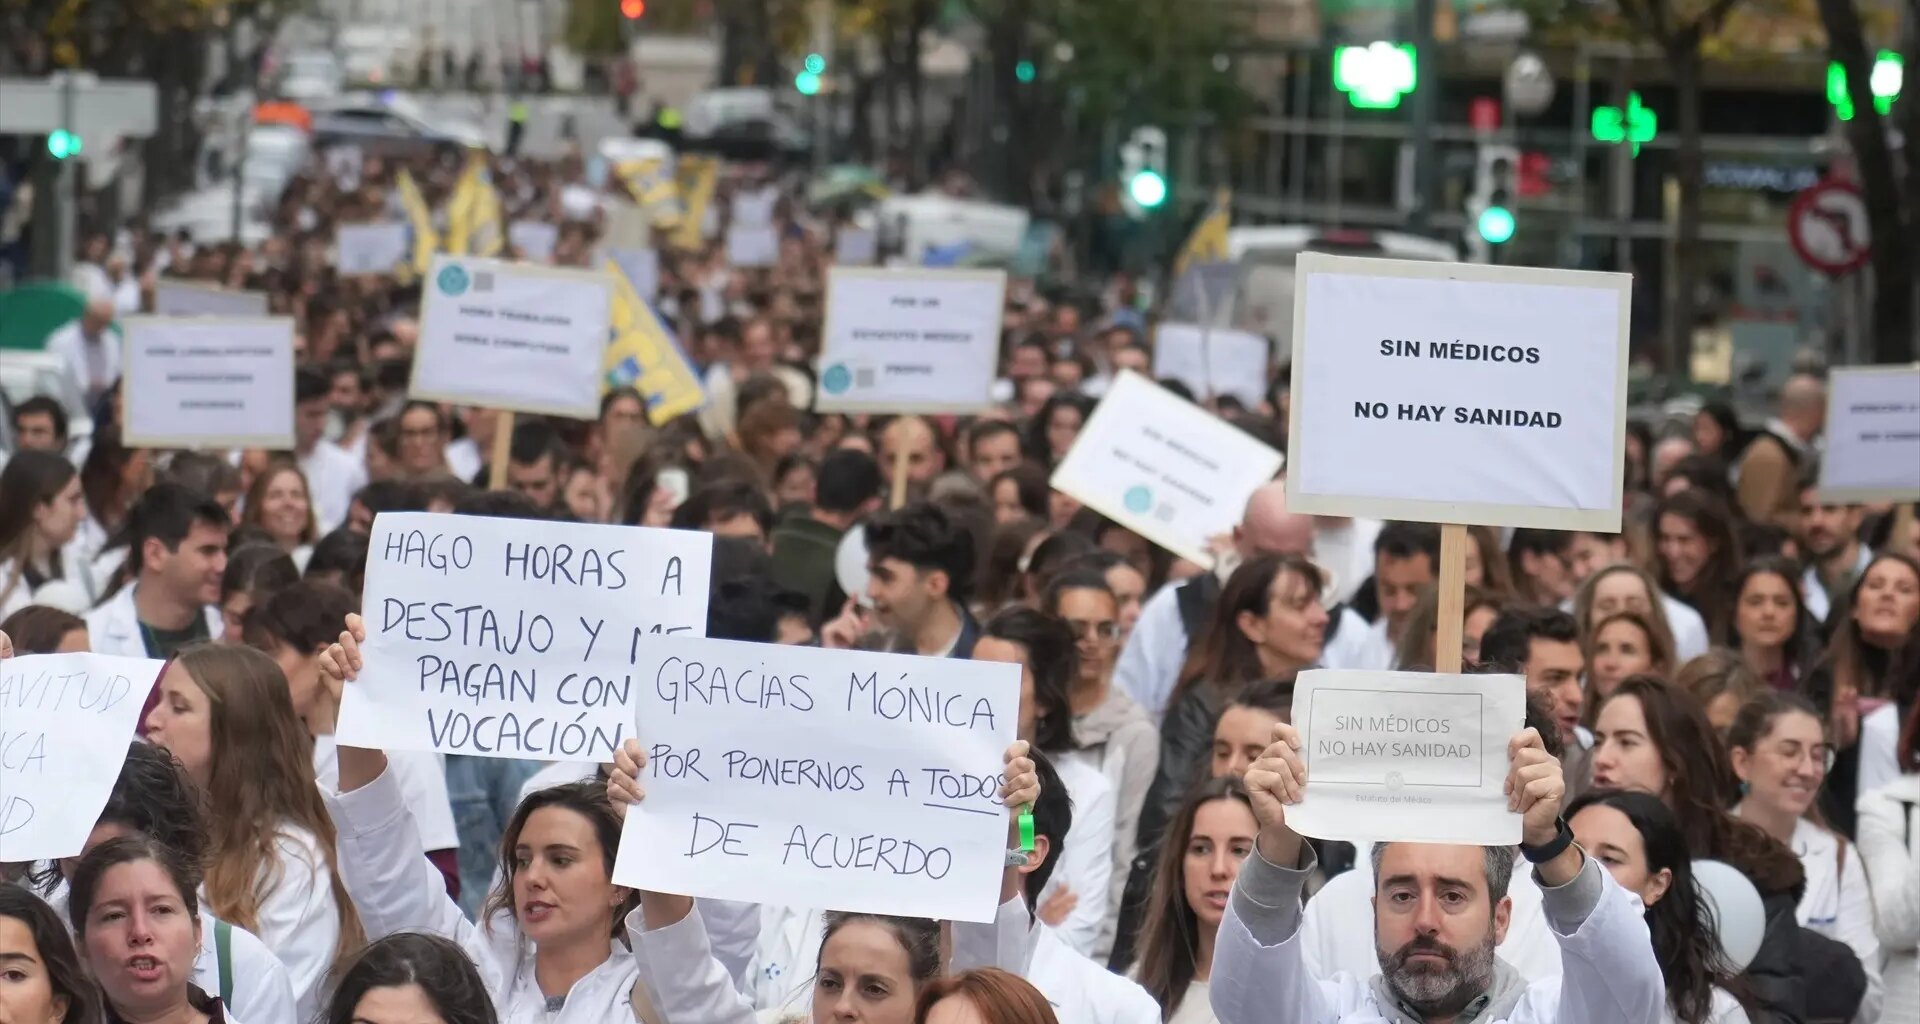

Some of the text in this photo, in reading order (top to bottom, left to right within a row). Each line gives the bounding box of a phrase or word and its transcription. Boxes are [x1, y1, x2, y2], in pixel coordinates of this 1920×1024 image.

[1380, 339, 1540, 364] SIN MÉDICOS
[1354, 401, 1562, 428] NO HAY SANIDAD
[385, 530, 682, 596] HAGO HORAS A
[382, 598, 554, 655] DESTAJO
[580, 616, 605, 662] Y
[417, 655, 631, 708] PAGAN CON
[848, 672, 995, 731] MÓNICA
[427, 711, 623, 756] VOCACIÓN
[1335, 714, 1450, 733] SIN MÉDICOS
[650, 744, 709, 782] POR
[722, 750, 865, 792] PONERNOS
[887, 769, 911, 797] A
[1319, 740, 1471, 759] NO HAY SANIDAD
[1390, 795, 1402, 804] del
[684, 812, 951, 880] DE ACUERDO
